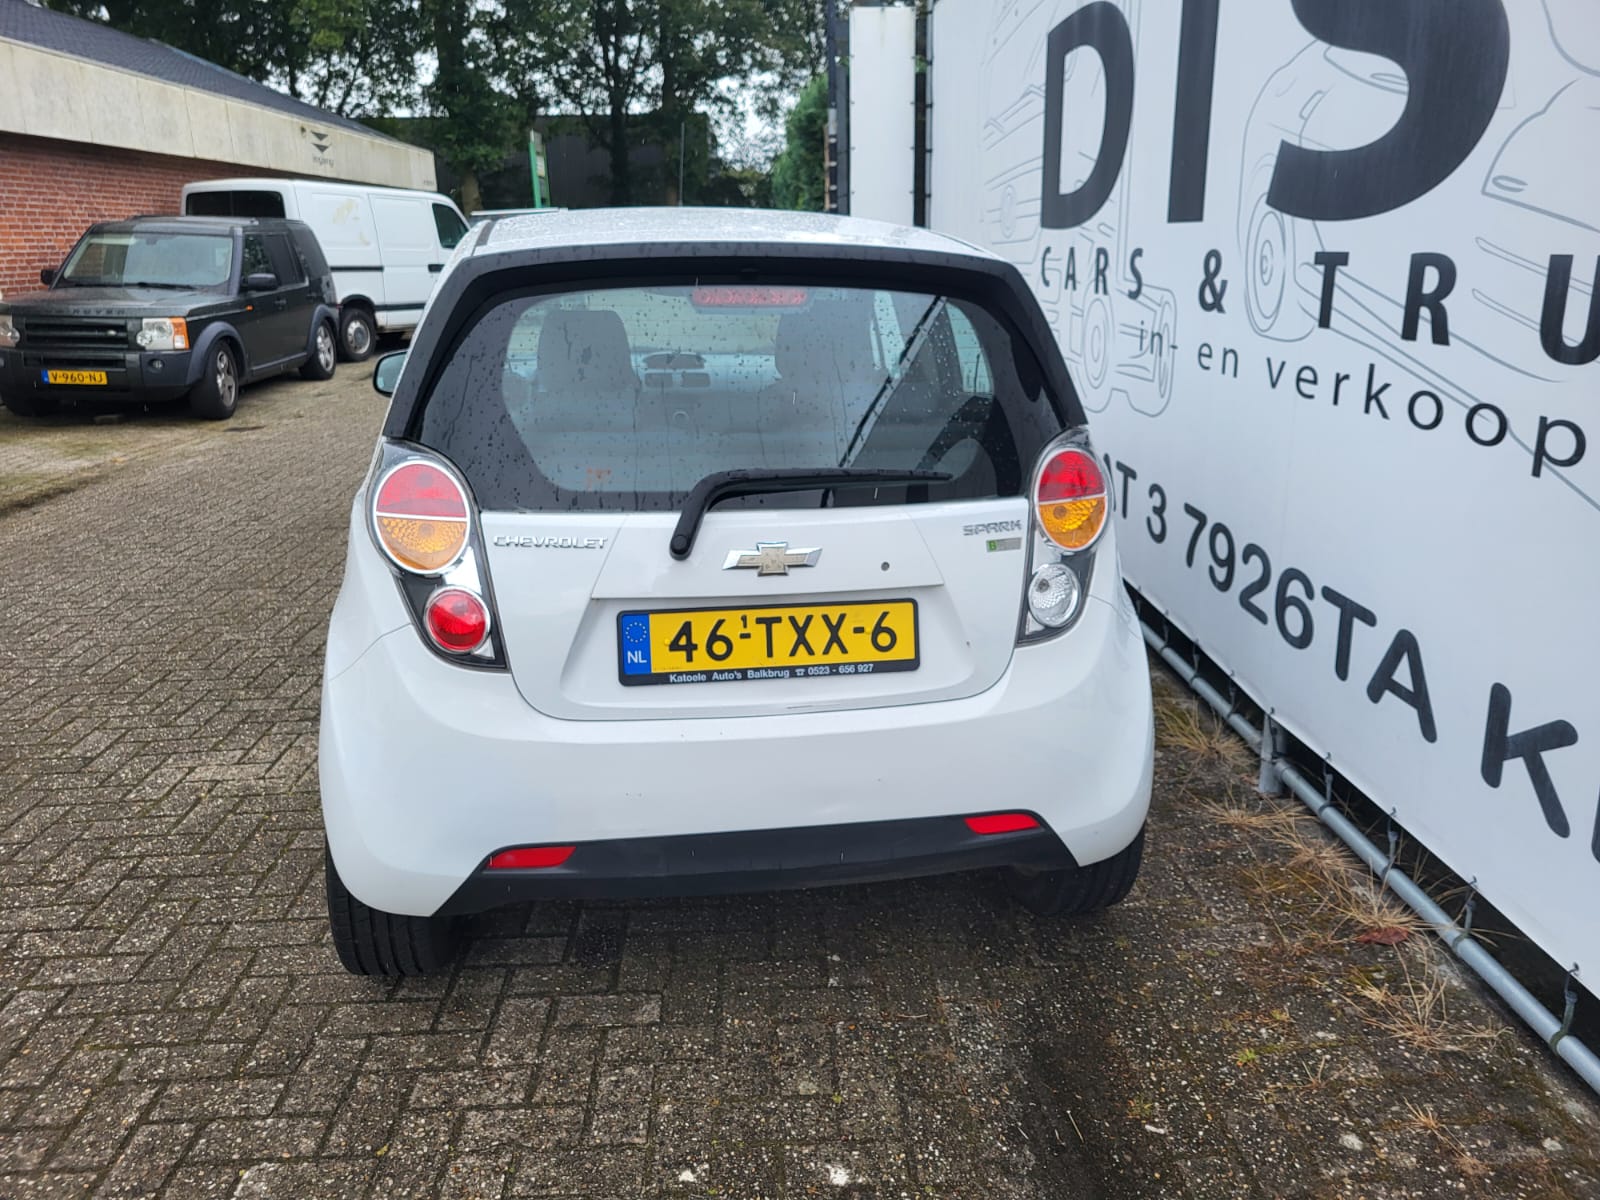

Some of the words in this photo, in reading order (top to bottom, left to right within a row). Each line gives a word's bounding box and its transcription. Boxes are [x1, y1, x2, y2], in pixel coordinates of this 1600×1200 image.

[1041, 246, 1144, 300] CARS
[1198, 249, 1229, 314] &
[1197, 342, 1239, 379] en
[1266, 356, 1587, 478] verkoop
[1146, 483, 1167, 545] 3
[963, 519, 1022, 537] SPARK
[493, 535, 608, 550] CHEVROLET
[627, 650, 648, 664] NL
[712, 671, 742, 682] Auto's
[747, 667, 790, 679] Balkbrug
[807, 666, 830, 675] 0523
[838, 664, 855, 673] 656
[857, 663, 873, 672] 927
